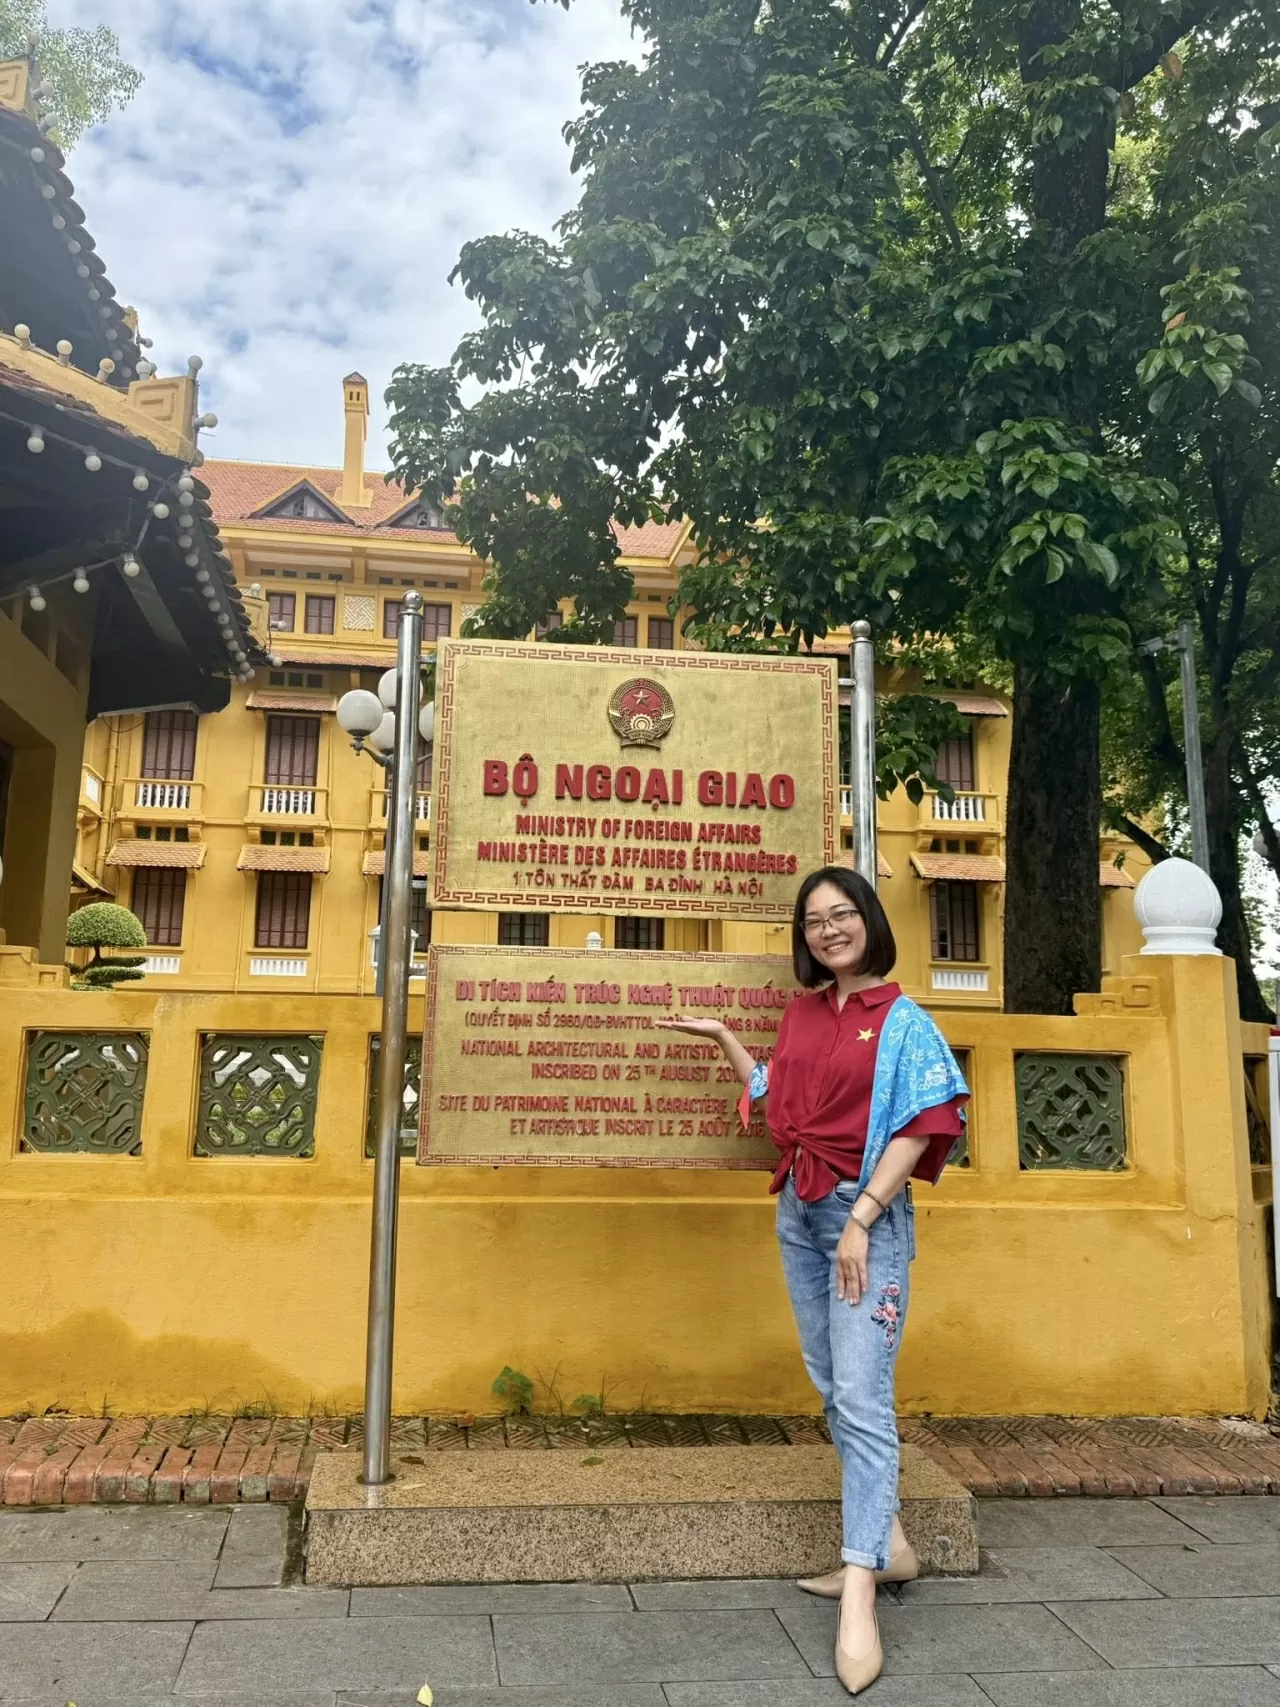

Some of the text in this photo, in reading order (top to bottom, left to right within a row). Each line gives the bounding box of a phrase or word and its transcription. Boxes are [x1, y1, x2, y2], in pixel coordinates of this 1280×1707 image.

[483, 753, 795, 811] BỘ NGOẠI GIAO
[515, 815, 761, 845] MINISTRY OF FOREIGN AFFAIRS
[477, 838, 569, 864] MINISTÈRE
[574, 845, 605, 867] DES
[611, 847, 686, 870] AFFAIRES
[525, 868, 555, 887] TÔN
[561, 867, 597, 889] THẤT
[645, 876, 664, 891] BA
[668, 874, 703, 893] ĐÌNH
[713, 875, 733, 895] HÀ
[738, 877, 763, 899] NỘI
[456, 975, 786, 1012] DI TÍCH KIẾN TRÚC NGHỆ THUẬT QUỐC
[465, 1006, 505, 1028] (QUYẾT
[536, 1006, 551, 1028] SỐ
[461, 1040, 522, 1056] NATIONAL
[527, 1041, 628, 1058] ARCHITECTURAL
[634, 1043, 660, 1059] AND
[664, 1044, 719, 1060] ARTISTIC
[531, 1063, 597, 1080] INSCRIBED
[602, 1064, 621, 1080] ON
[659, 1065, 710, 1082] AUGUST
[438, 1095, 467, 1112] SITE
[472, 1095, 489, 1112] DU
[494, 1095, 569, 1112] PATRIMOINE
[574, 1096, 637, 1113] NATIONAL
[656, 1094, 728, 1114] CARACTÈRE
[510, 1118, 527, 1135] ET
[604, 1119, 654, 1136] INSCRIT
[658, 1119, 673, 1136] LE
[678, 1120, 694, 1136] 25
[697, 1116, 731, 1137] AOÛT
